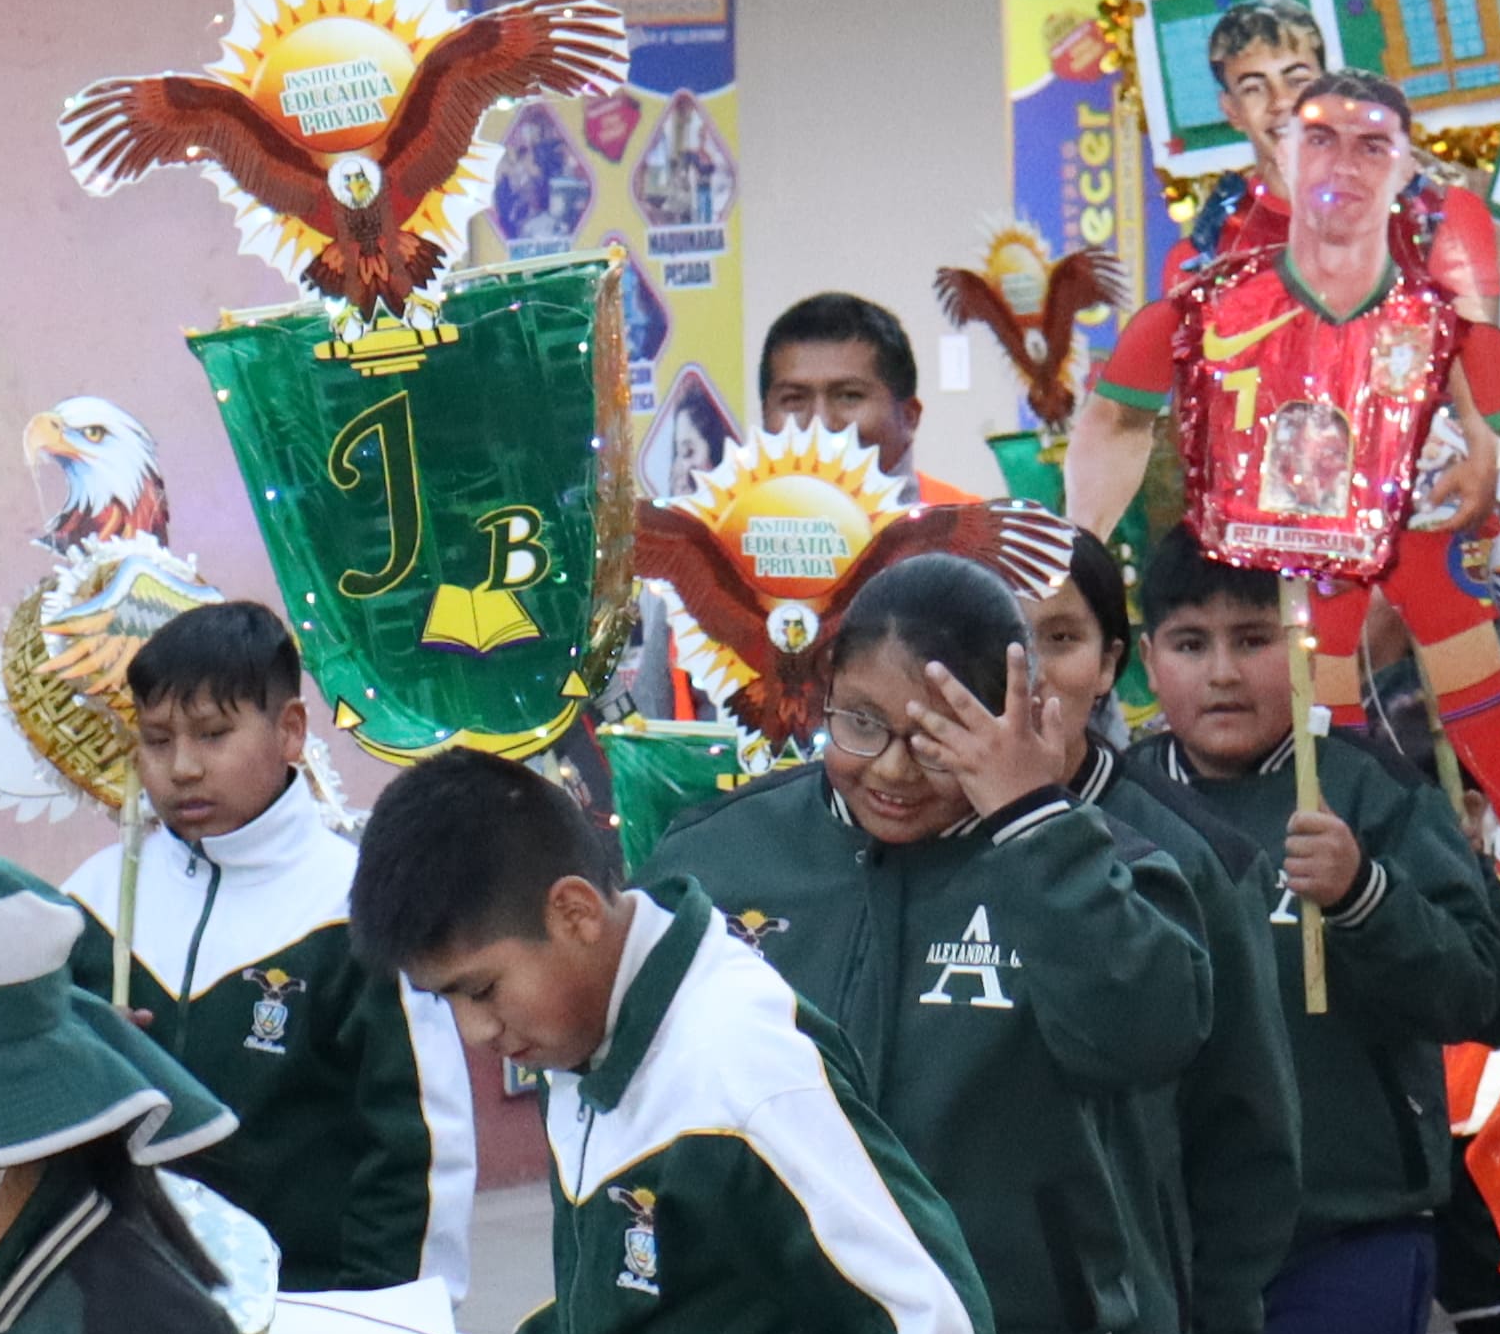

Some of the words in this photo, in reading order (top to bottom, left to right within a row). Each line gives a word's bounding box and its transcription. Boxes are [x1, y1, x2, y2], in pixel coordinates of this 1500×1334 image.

[284, 59, 379, 95] INSTITUCIÓN
[280, 75, 394, 116] EDUCATIVA
[301, 100, 385, 135] PRIVADA
[741, 533, 849, 558] EDUCATIVA
[756, 555, 836, 578] PRIVADA
[924, 942, 1002, 965] ALEXANDRA
